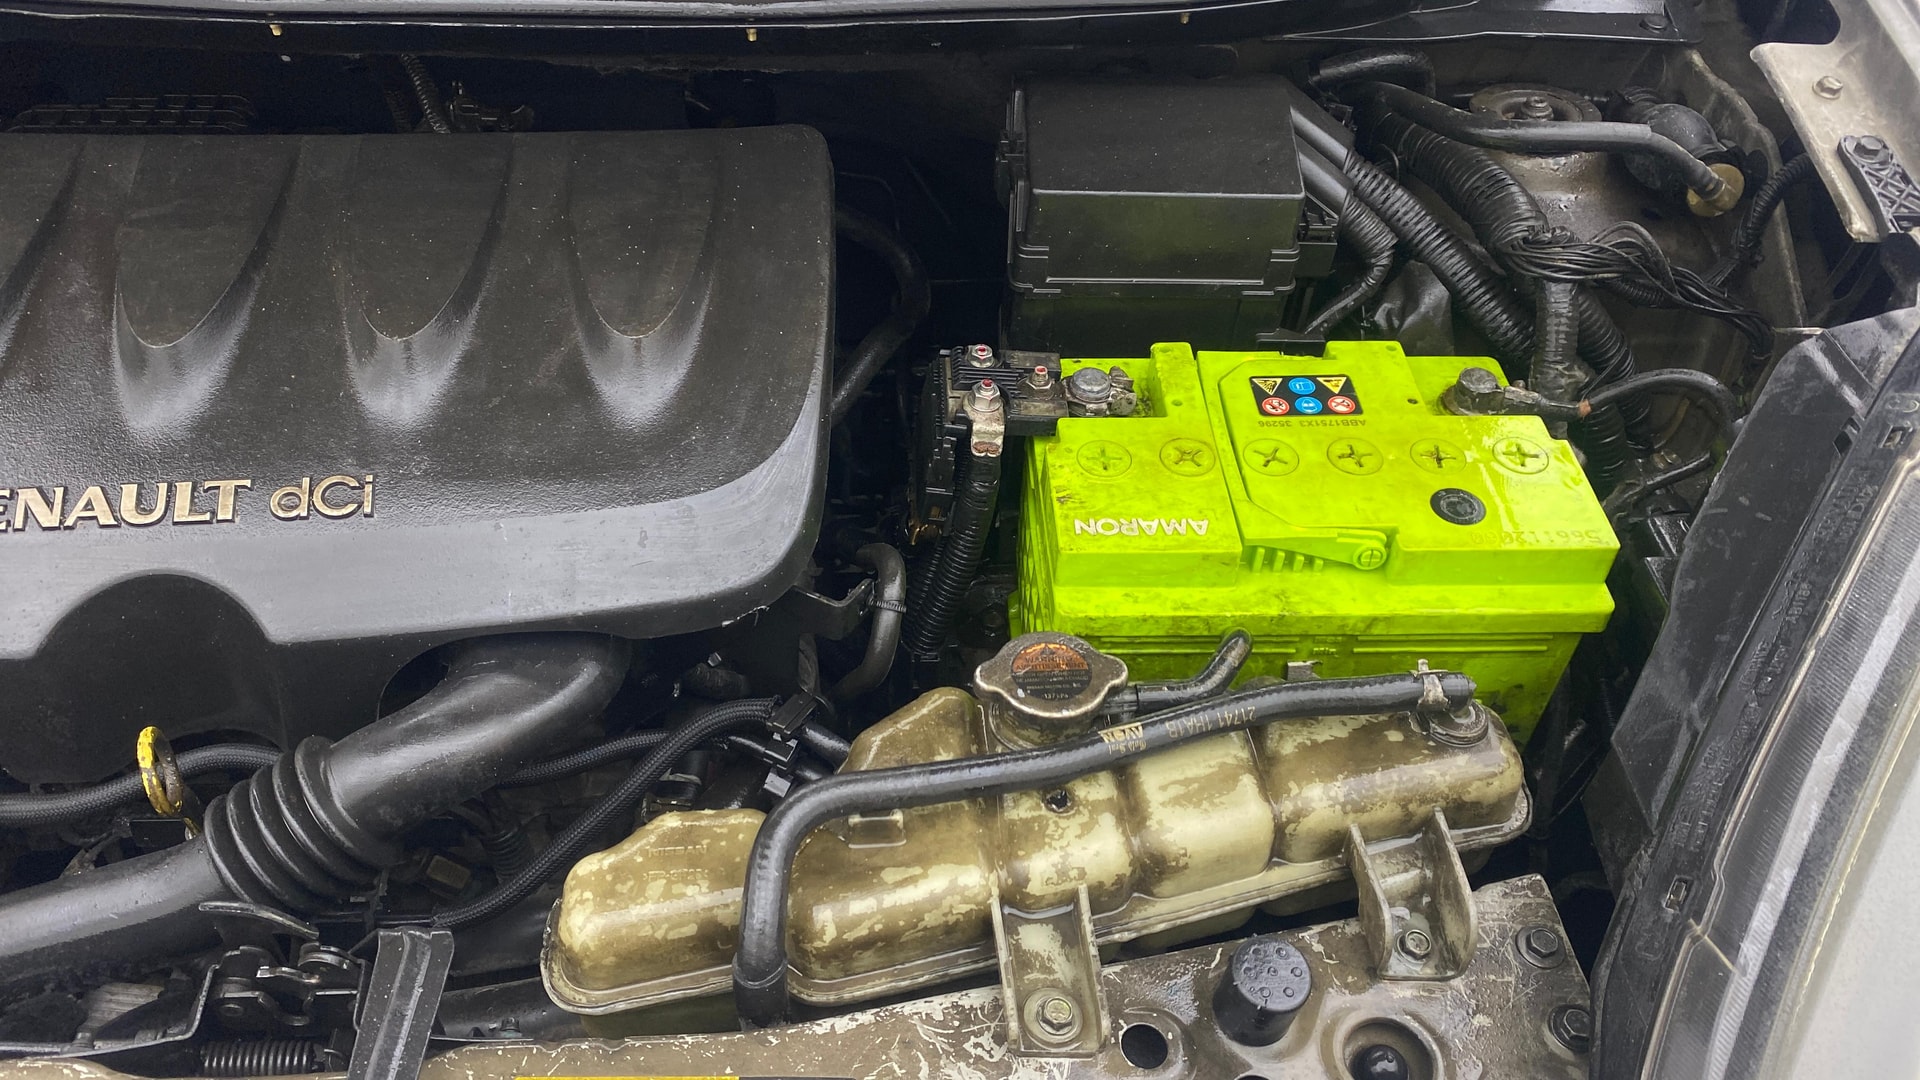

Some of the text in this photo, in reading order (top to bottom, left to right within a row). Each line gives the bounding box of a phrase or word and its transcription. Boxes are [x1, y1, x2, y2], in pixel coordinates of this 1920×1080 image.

[269, 474, 374, 520] dCi
[1074, 517, 1209, 536] AMARON
[1217, 706, 1256, 728] 21741
[1100, 725, 1144, 743] AVON
